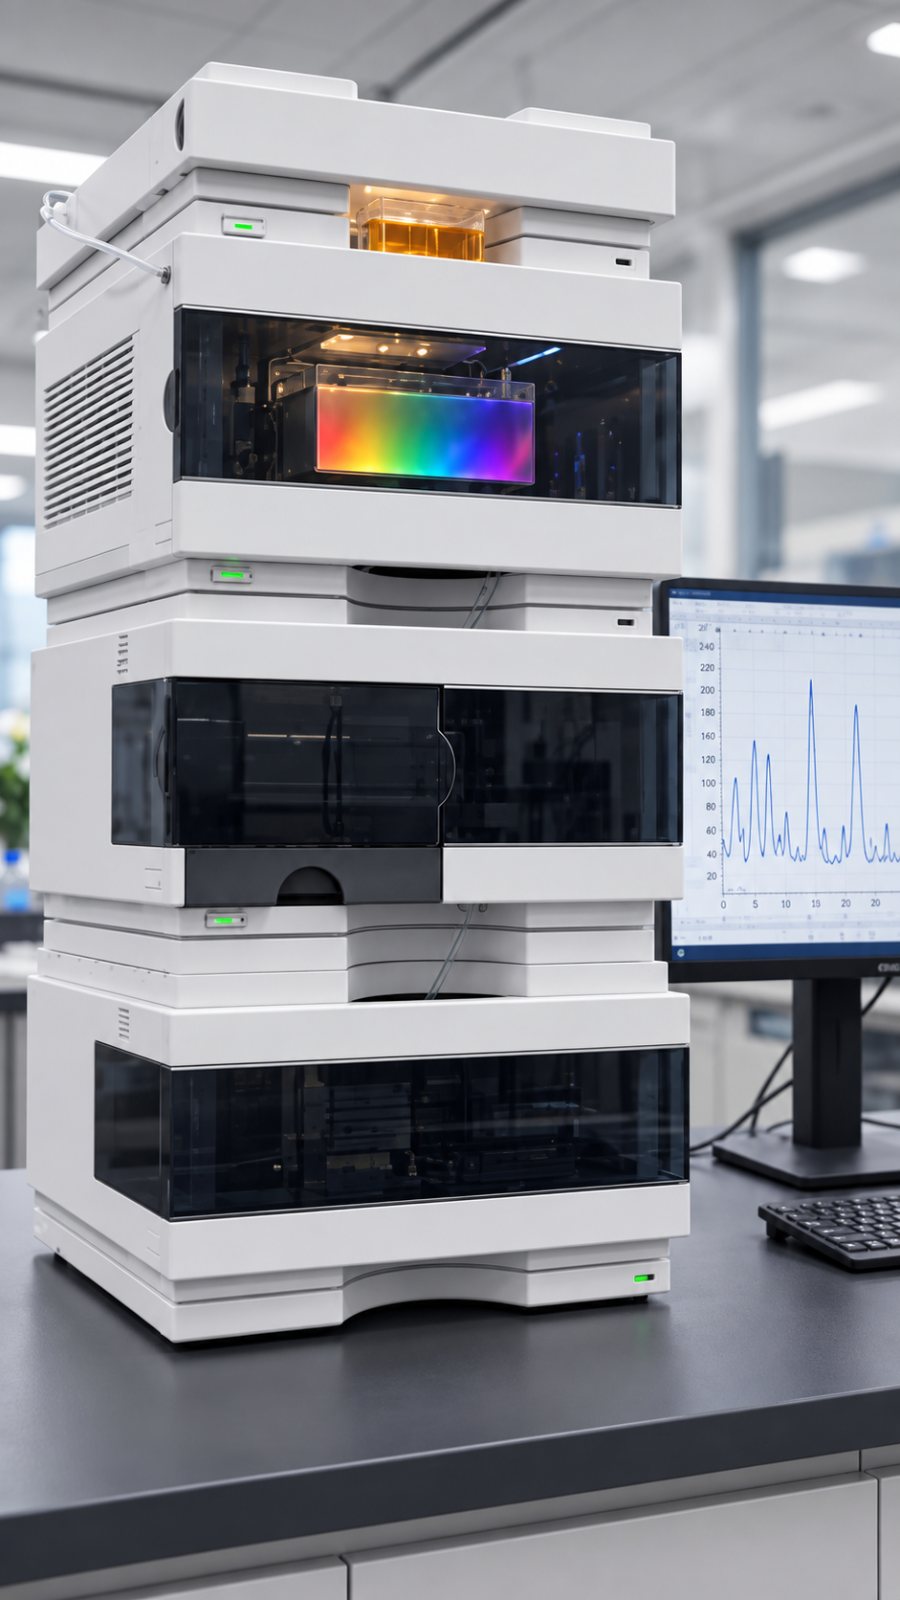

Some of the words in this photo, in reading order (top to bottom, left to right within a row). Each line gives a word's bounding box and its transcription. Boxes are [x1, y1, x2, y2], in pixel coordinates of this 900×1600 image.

[698, 642, 714, 652] 240
[700, 664, 714, 672] 220
[700, 686, 716, 694] 200
[701, 708, 716, 716] 180
[701, 732, 716, 740] 160
[701, 756, 716, 764] 120
[701, 778, 716, 788] 100
[705, 802, 716, 812] 80
[705, 826, 716, 836] 60
[706, 850, 718, 858] 40
[706, 872, 718, 880] 20
[781, 900, 792, 908] 10
[840, 898, 852, 908] 20
[870, 898, 880, 908] 20
